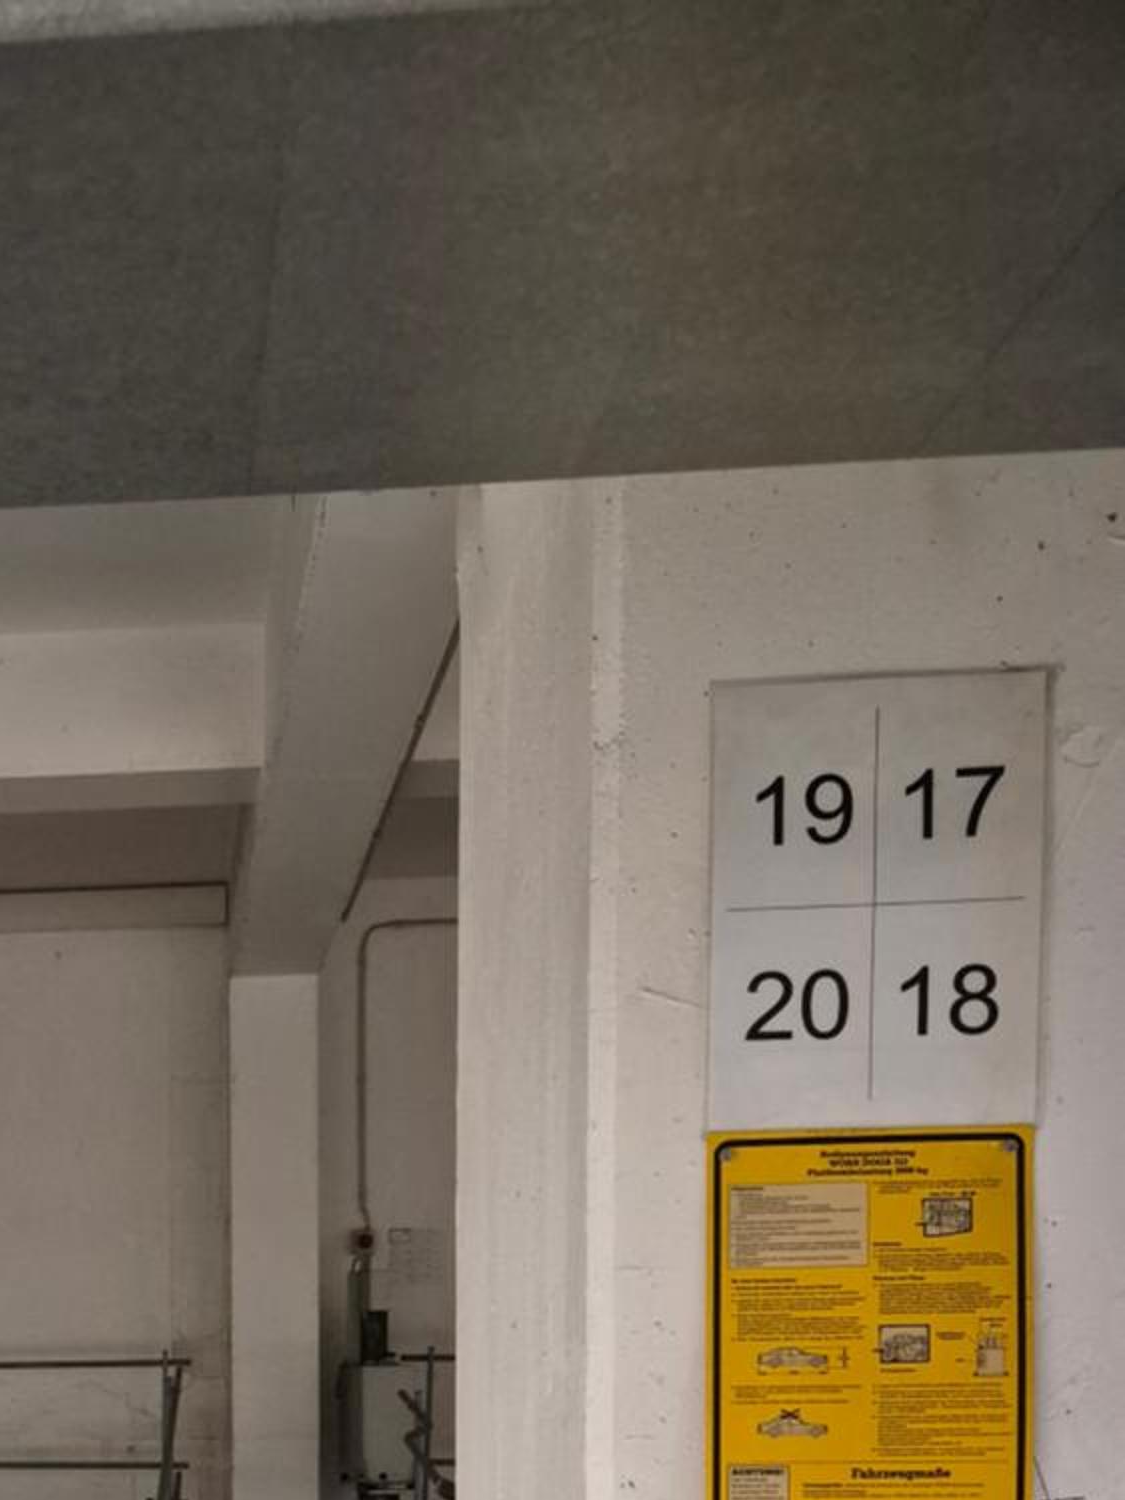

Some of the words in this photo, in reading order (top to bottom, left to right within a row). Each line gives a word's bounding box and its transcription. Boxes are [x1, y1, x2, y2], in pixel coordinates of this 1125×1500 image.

[755, 773, 854, 846] 19
[904, 765, 1005, 840] 17
[745, 969, 849, 1041] 20
[899, 963, 999, 1036] 18
